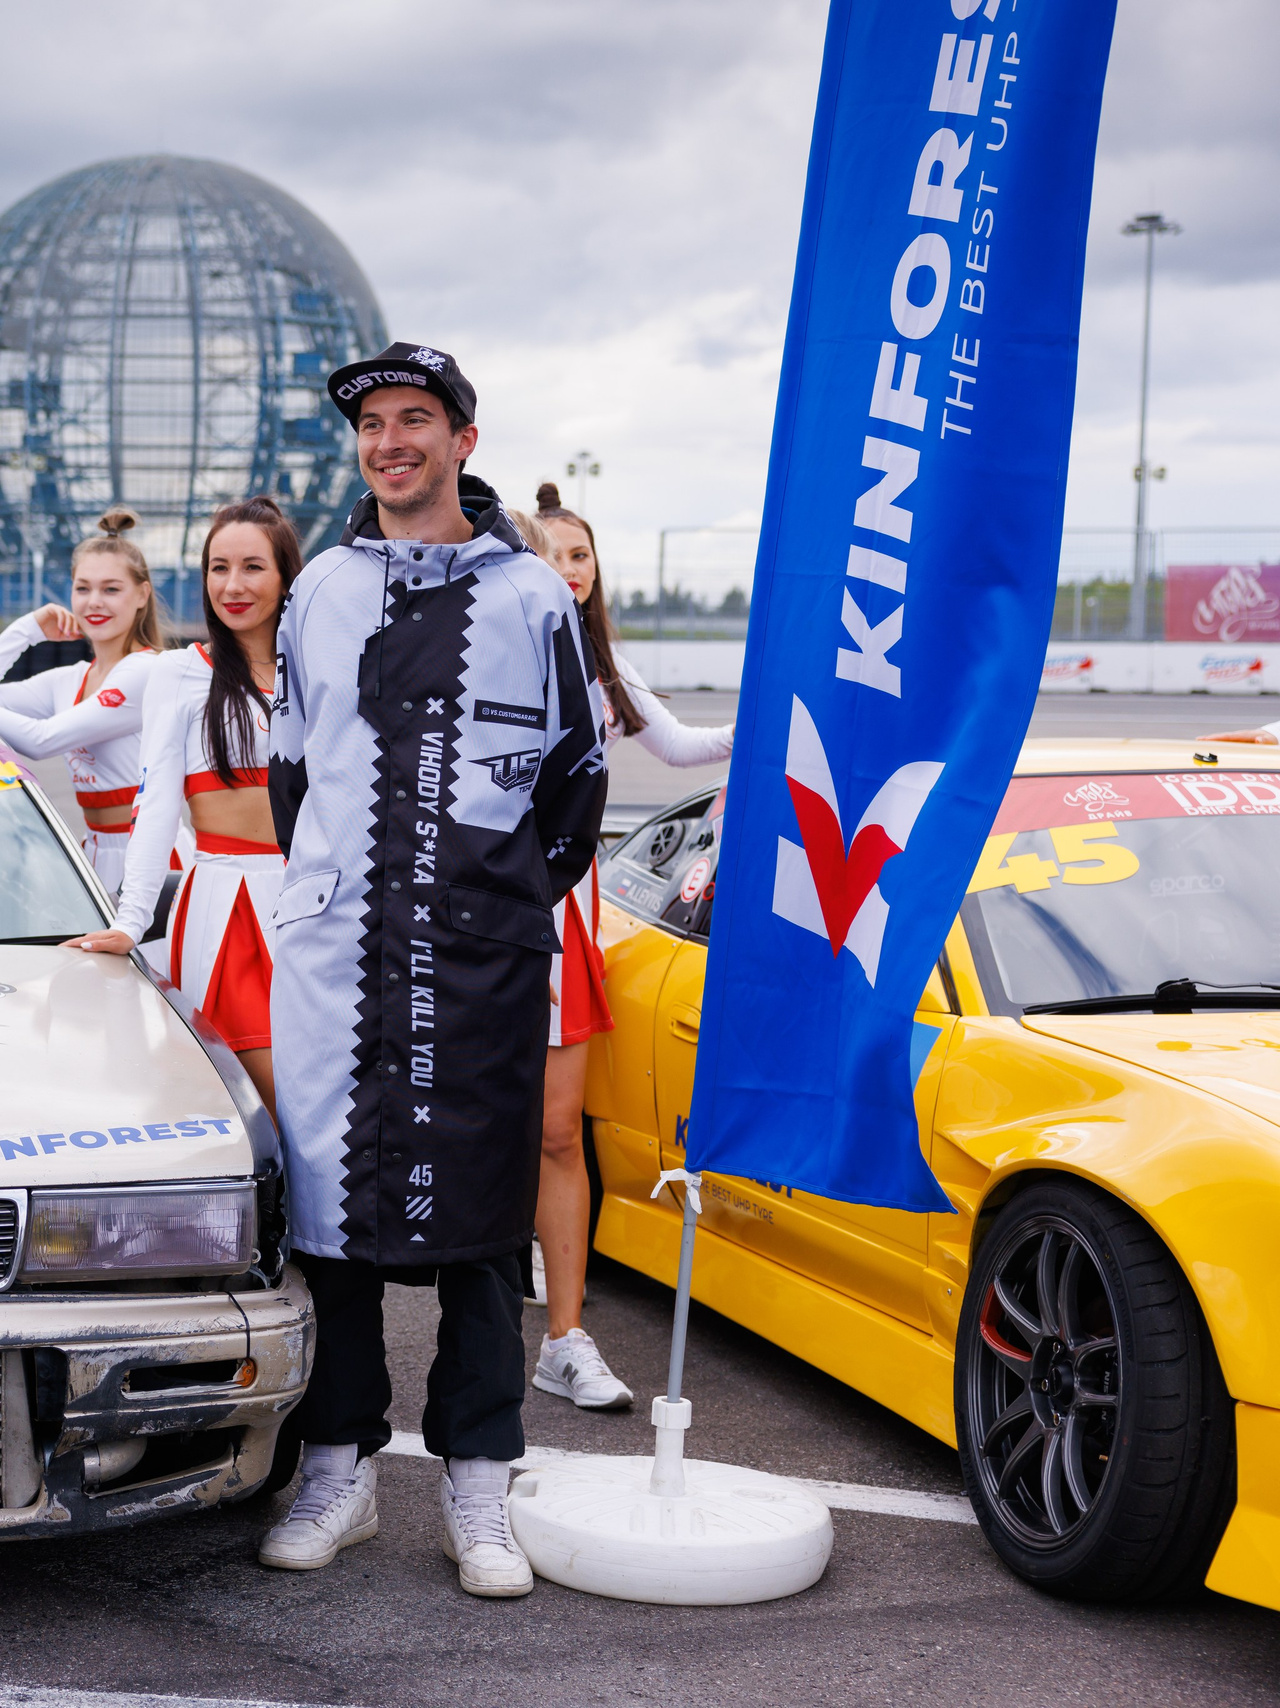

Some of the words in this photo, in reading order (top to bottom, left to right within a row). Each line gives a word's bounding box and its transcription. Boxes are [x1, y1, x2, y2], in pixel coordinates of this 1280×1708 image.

[985, 31, 1021, 151] UHP
[959, 170, 1001, 315] BEST
[835, 0, 1001, 699] KINFORE
[336, 370, 427, 400] CUSTOMS
[941, 338, 980, 439] THE
[417, 732, 444, 816] VIHODY
[1154, 773, 1233, 783] IGORA
[1087, 809, 1133, 820] ДРАЙВ
[1183, 805, 1237, 816] DRIFT
[966, 820, 1140, 894] 45
[410, 939, 434, 978] I'LL
[410, 984, 435, 1032] KILL
[410, 1043, 435, 1088] YOU
[408, 1164, 433, 1187] 45
[701, 1180, 710, 1194] HE
[711, 1183, 731, 1203] BEST
[733, 1193, 751, 1210] UHP
[752, 1203, 774, 1225] TYRE
